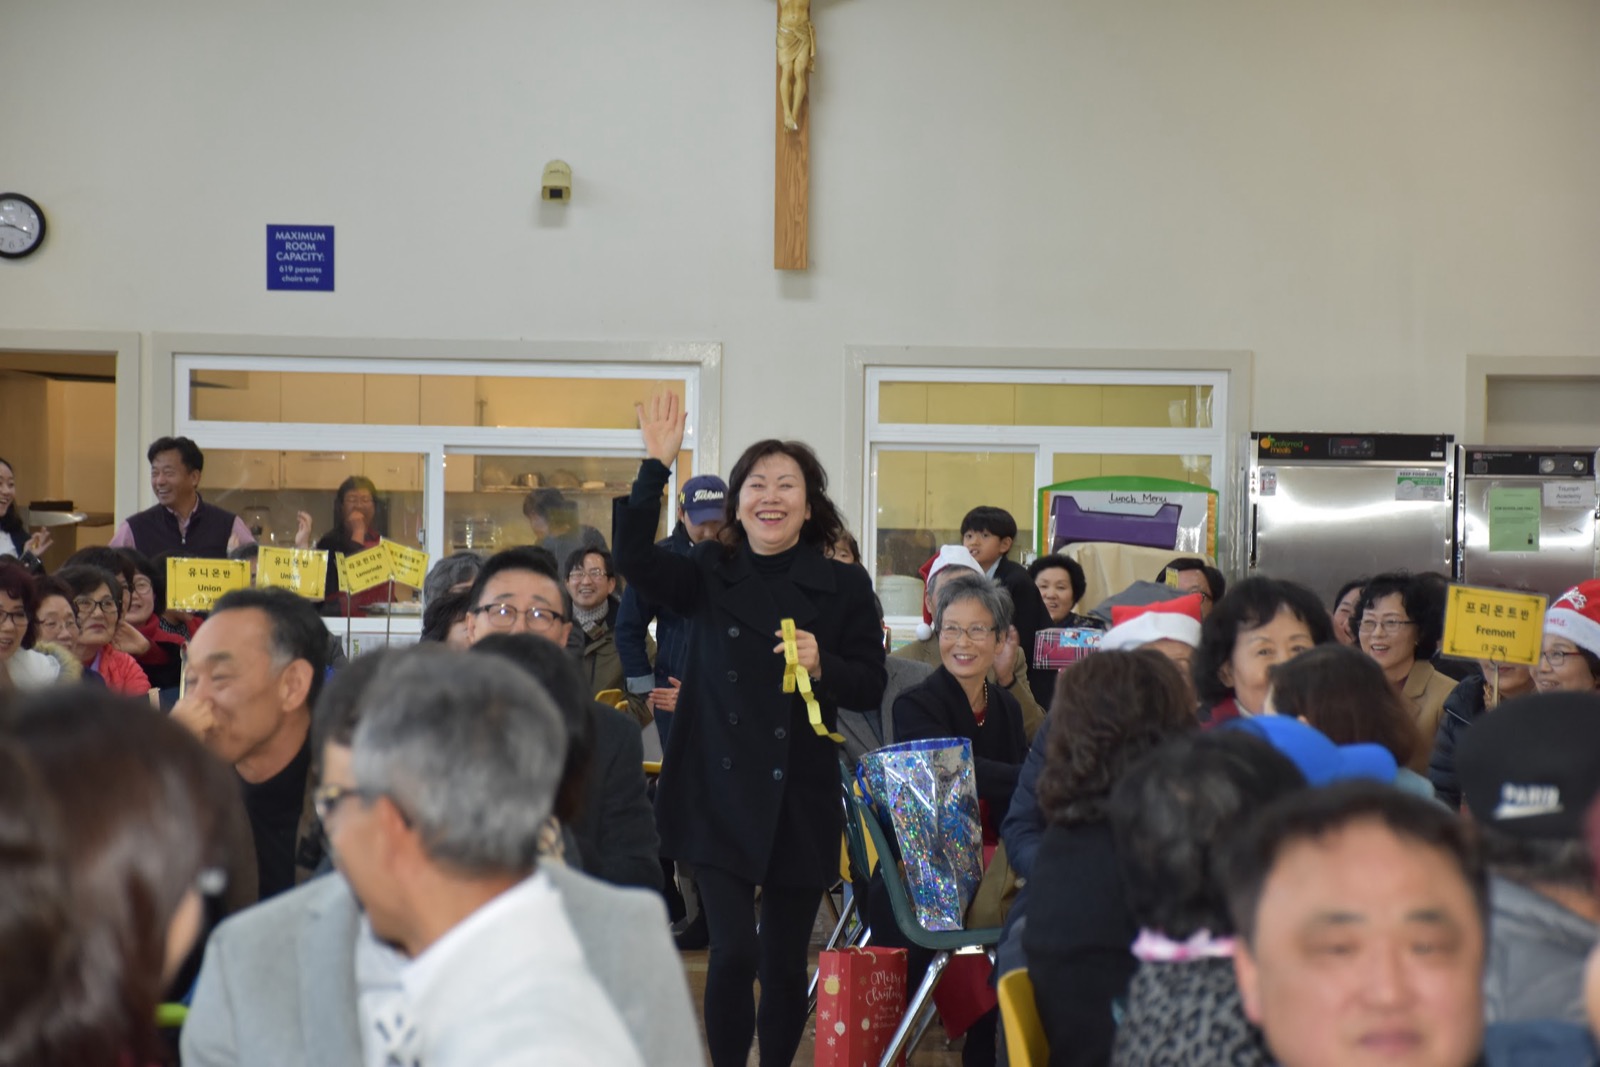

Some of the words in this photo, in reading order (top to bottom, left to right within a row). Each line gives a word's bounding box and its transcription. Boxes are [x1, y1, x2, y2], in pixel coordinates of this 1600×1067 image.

[275, 231, 326, 241] MAXIMUM
[285, 241, 316, 251] ROOM
[275, 251, 325, 262] CAPACITY:
[279, 265, 293, 273] 619
[294, 266, 322, 274] persons
[281, 274, 303, 282] chairs
[304, 275, 320, 284] only
[1110, 492, 1136, 503] Lunch
[1142, 493, 1167, 503] Menu
[197, 584, 222, 592] Union
[1475, 625, 1516, 640] Fremont
[870, 970, 902, 988] Merry
